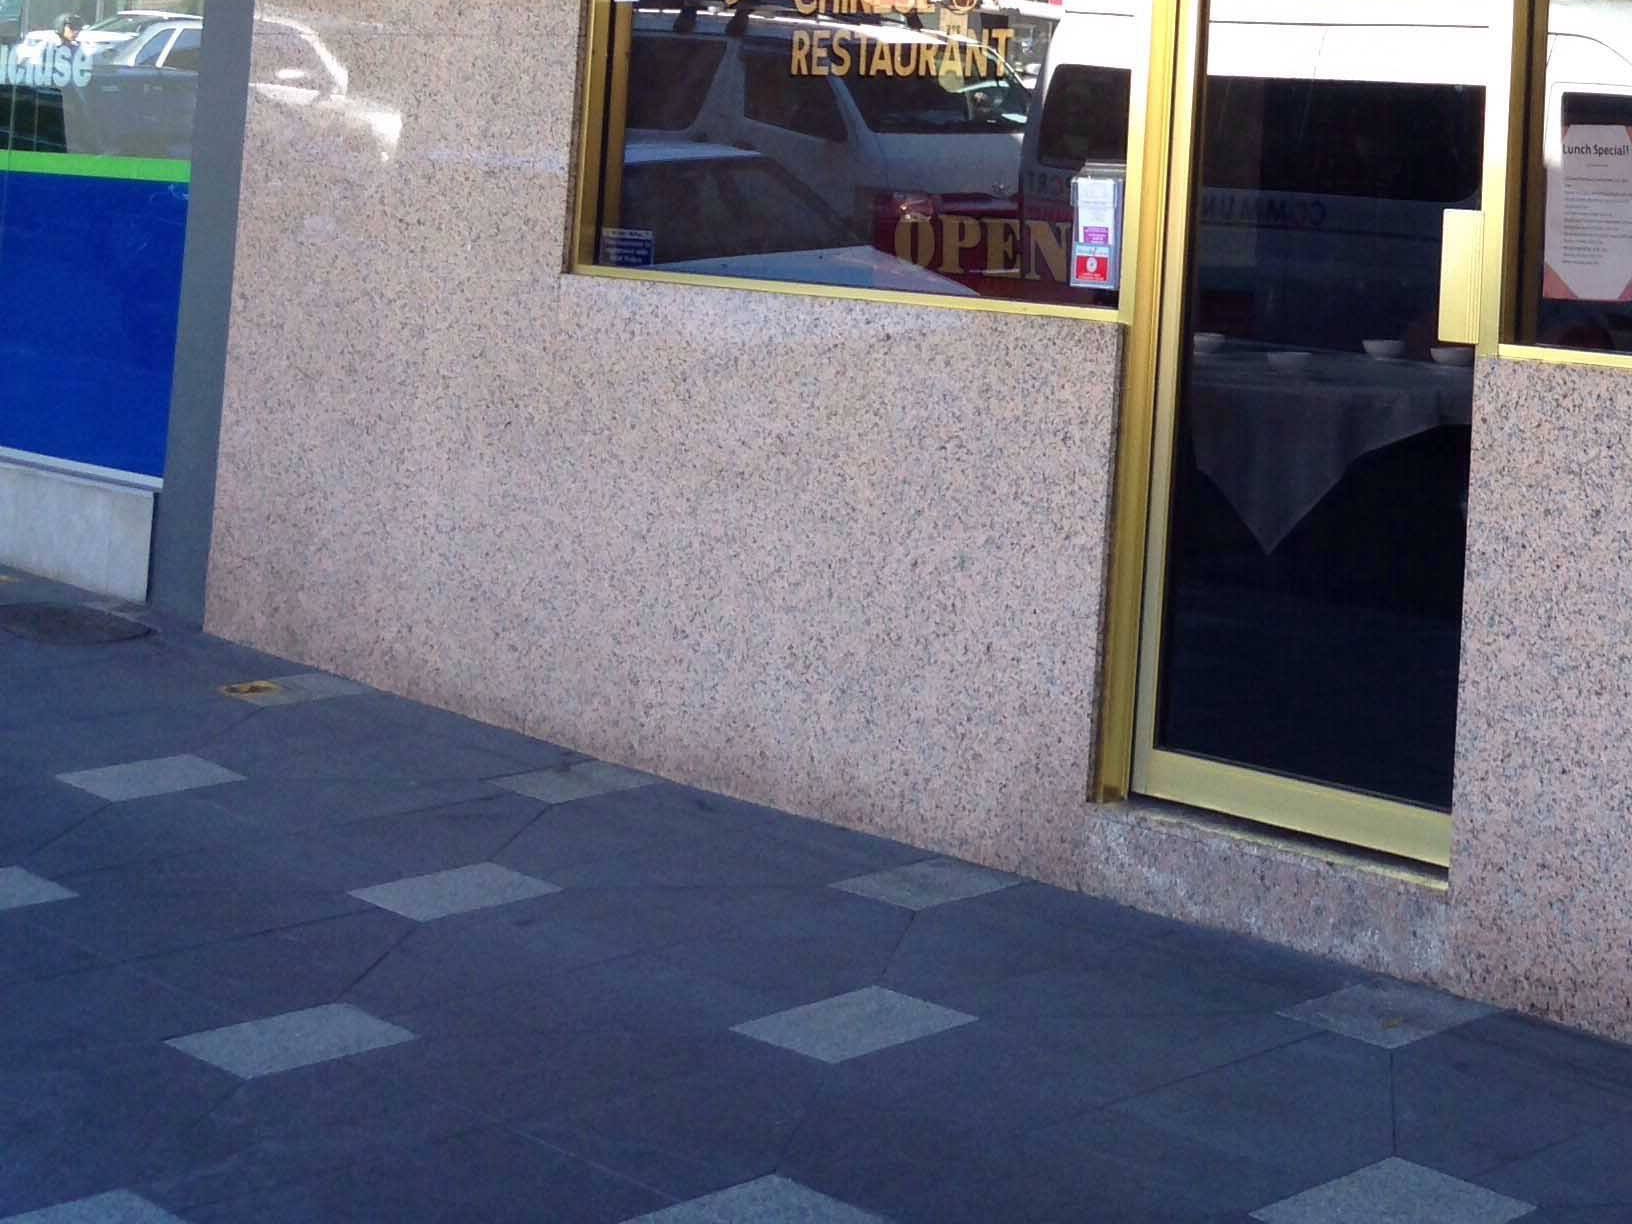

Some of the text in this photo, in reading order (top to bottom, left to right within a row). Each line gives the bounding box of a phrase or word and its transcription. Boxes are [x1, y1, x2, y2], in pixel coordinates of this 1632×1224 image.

[791, 28, 1016, 78] RESTAURANT
[1562, 143, 1630, 157] Lunch Special!
[895, 215, 1072, 283] OPEN
